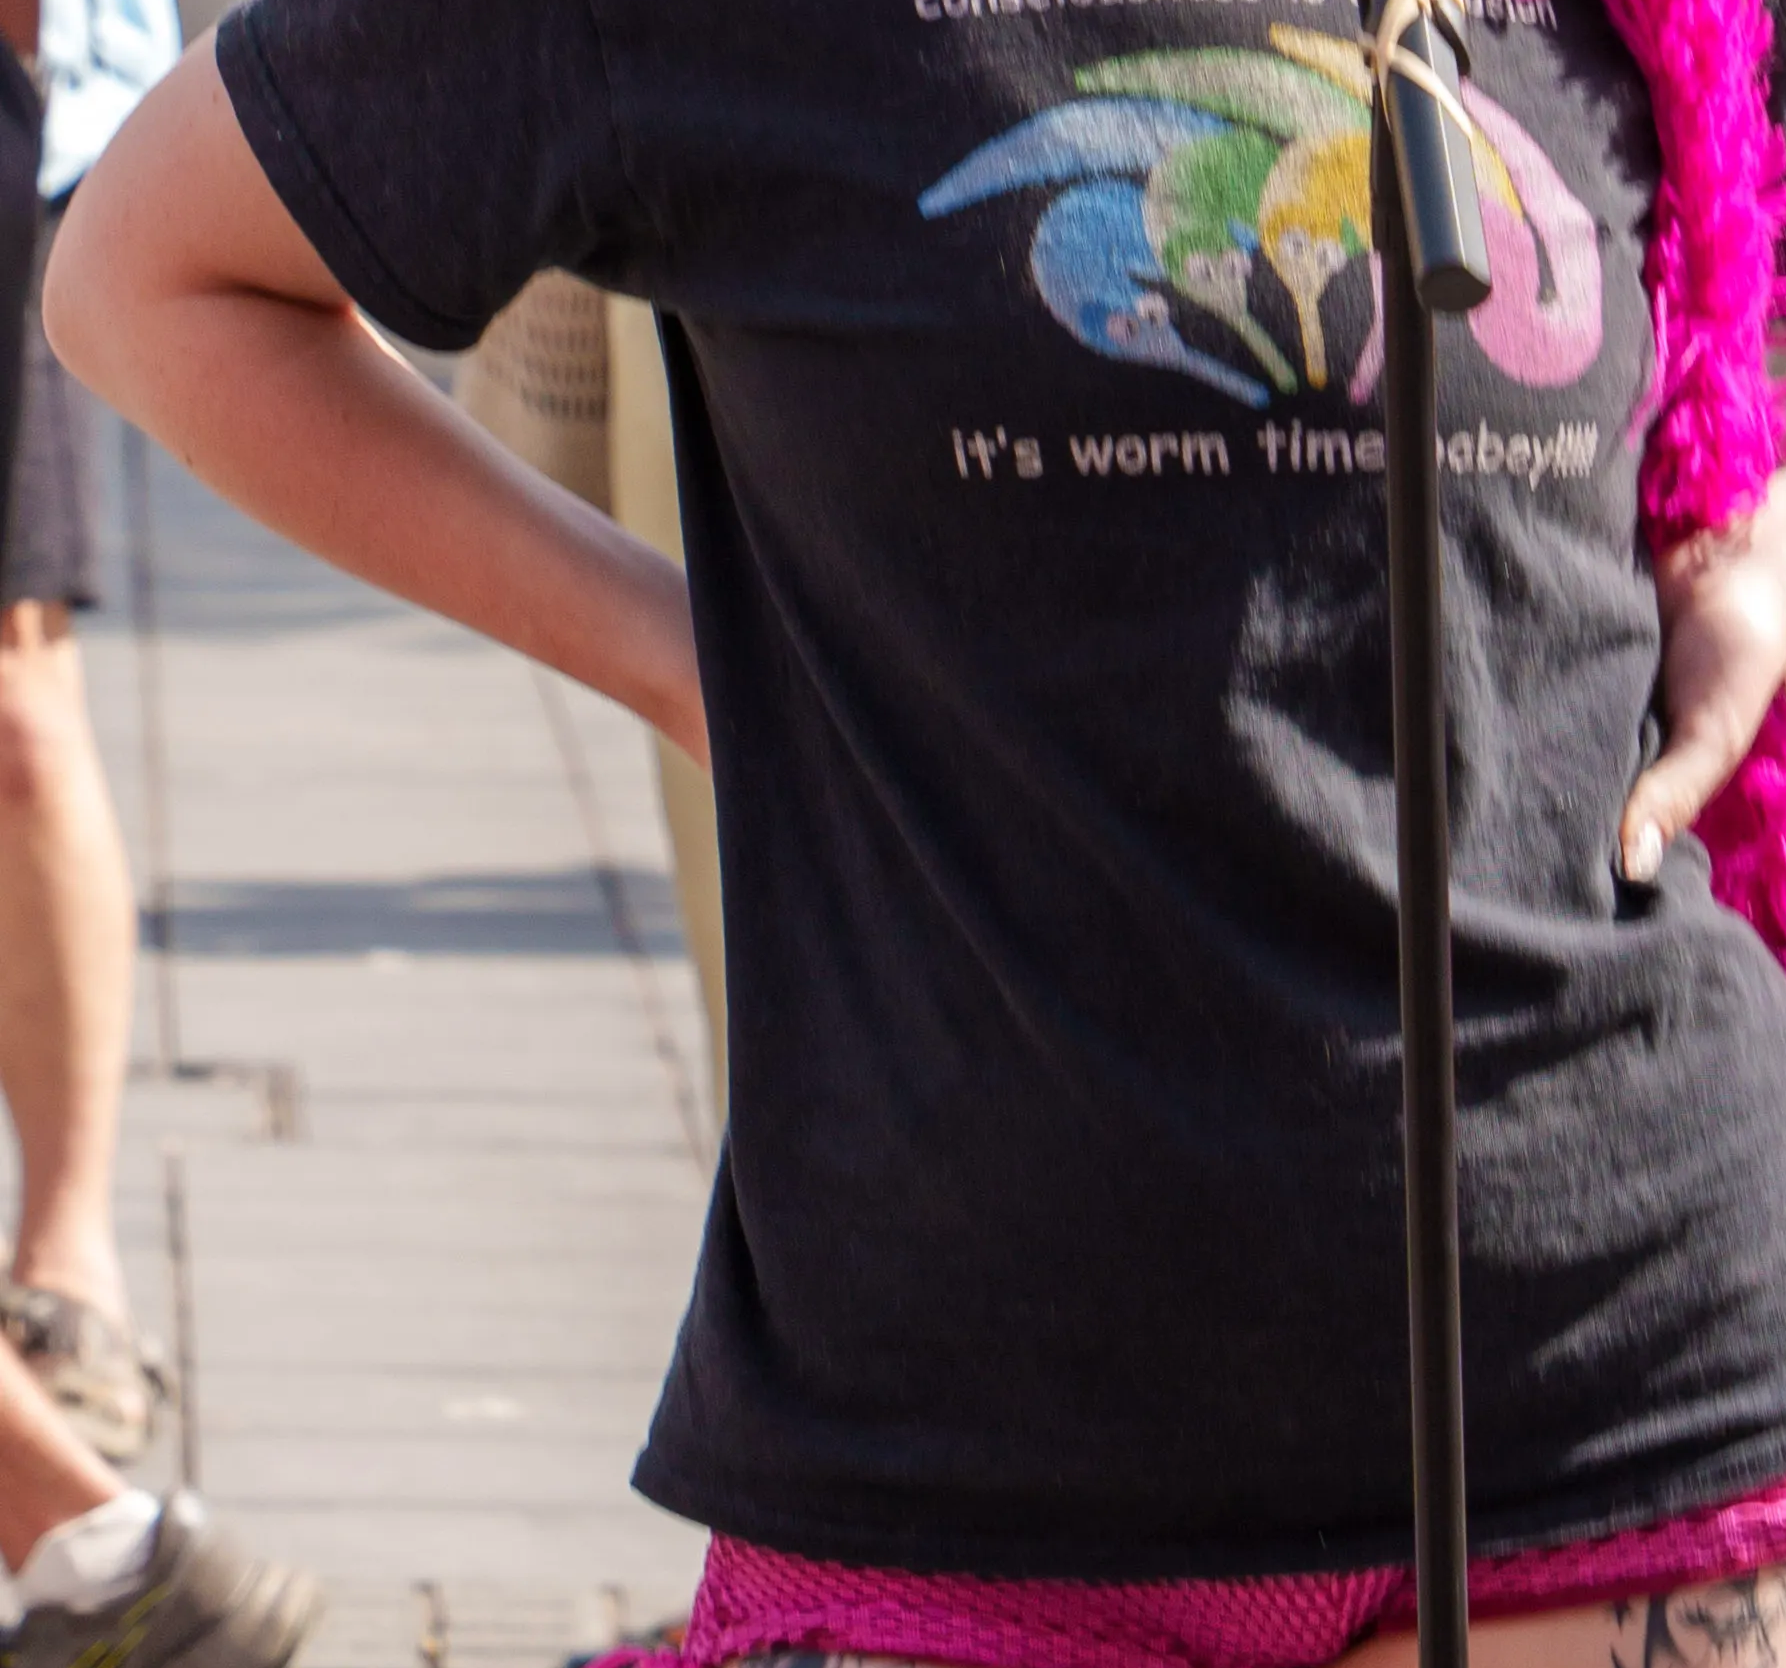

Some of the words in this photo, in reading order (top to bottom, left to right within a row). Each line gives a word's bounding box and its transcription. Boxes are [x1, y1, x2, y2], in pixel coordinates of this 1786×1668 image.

[952, 424, 1043, 481] it's
[1069, 430, 1231, 477] worm
[1256, 416, 1386, 475] time
